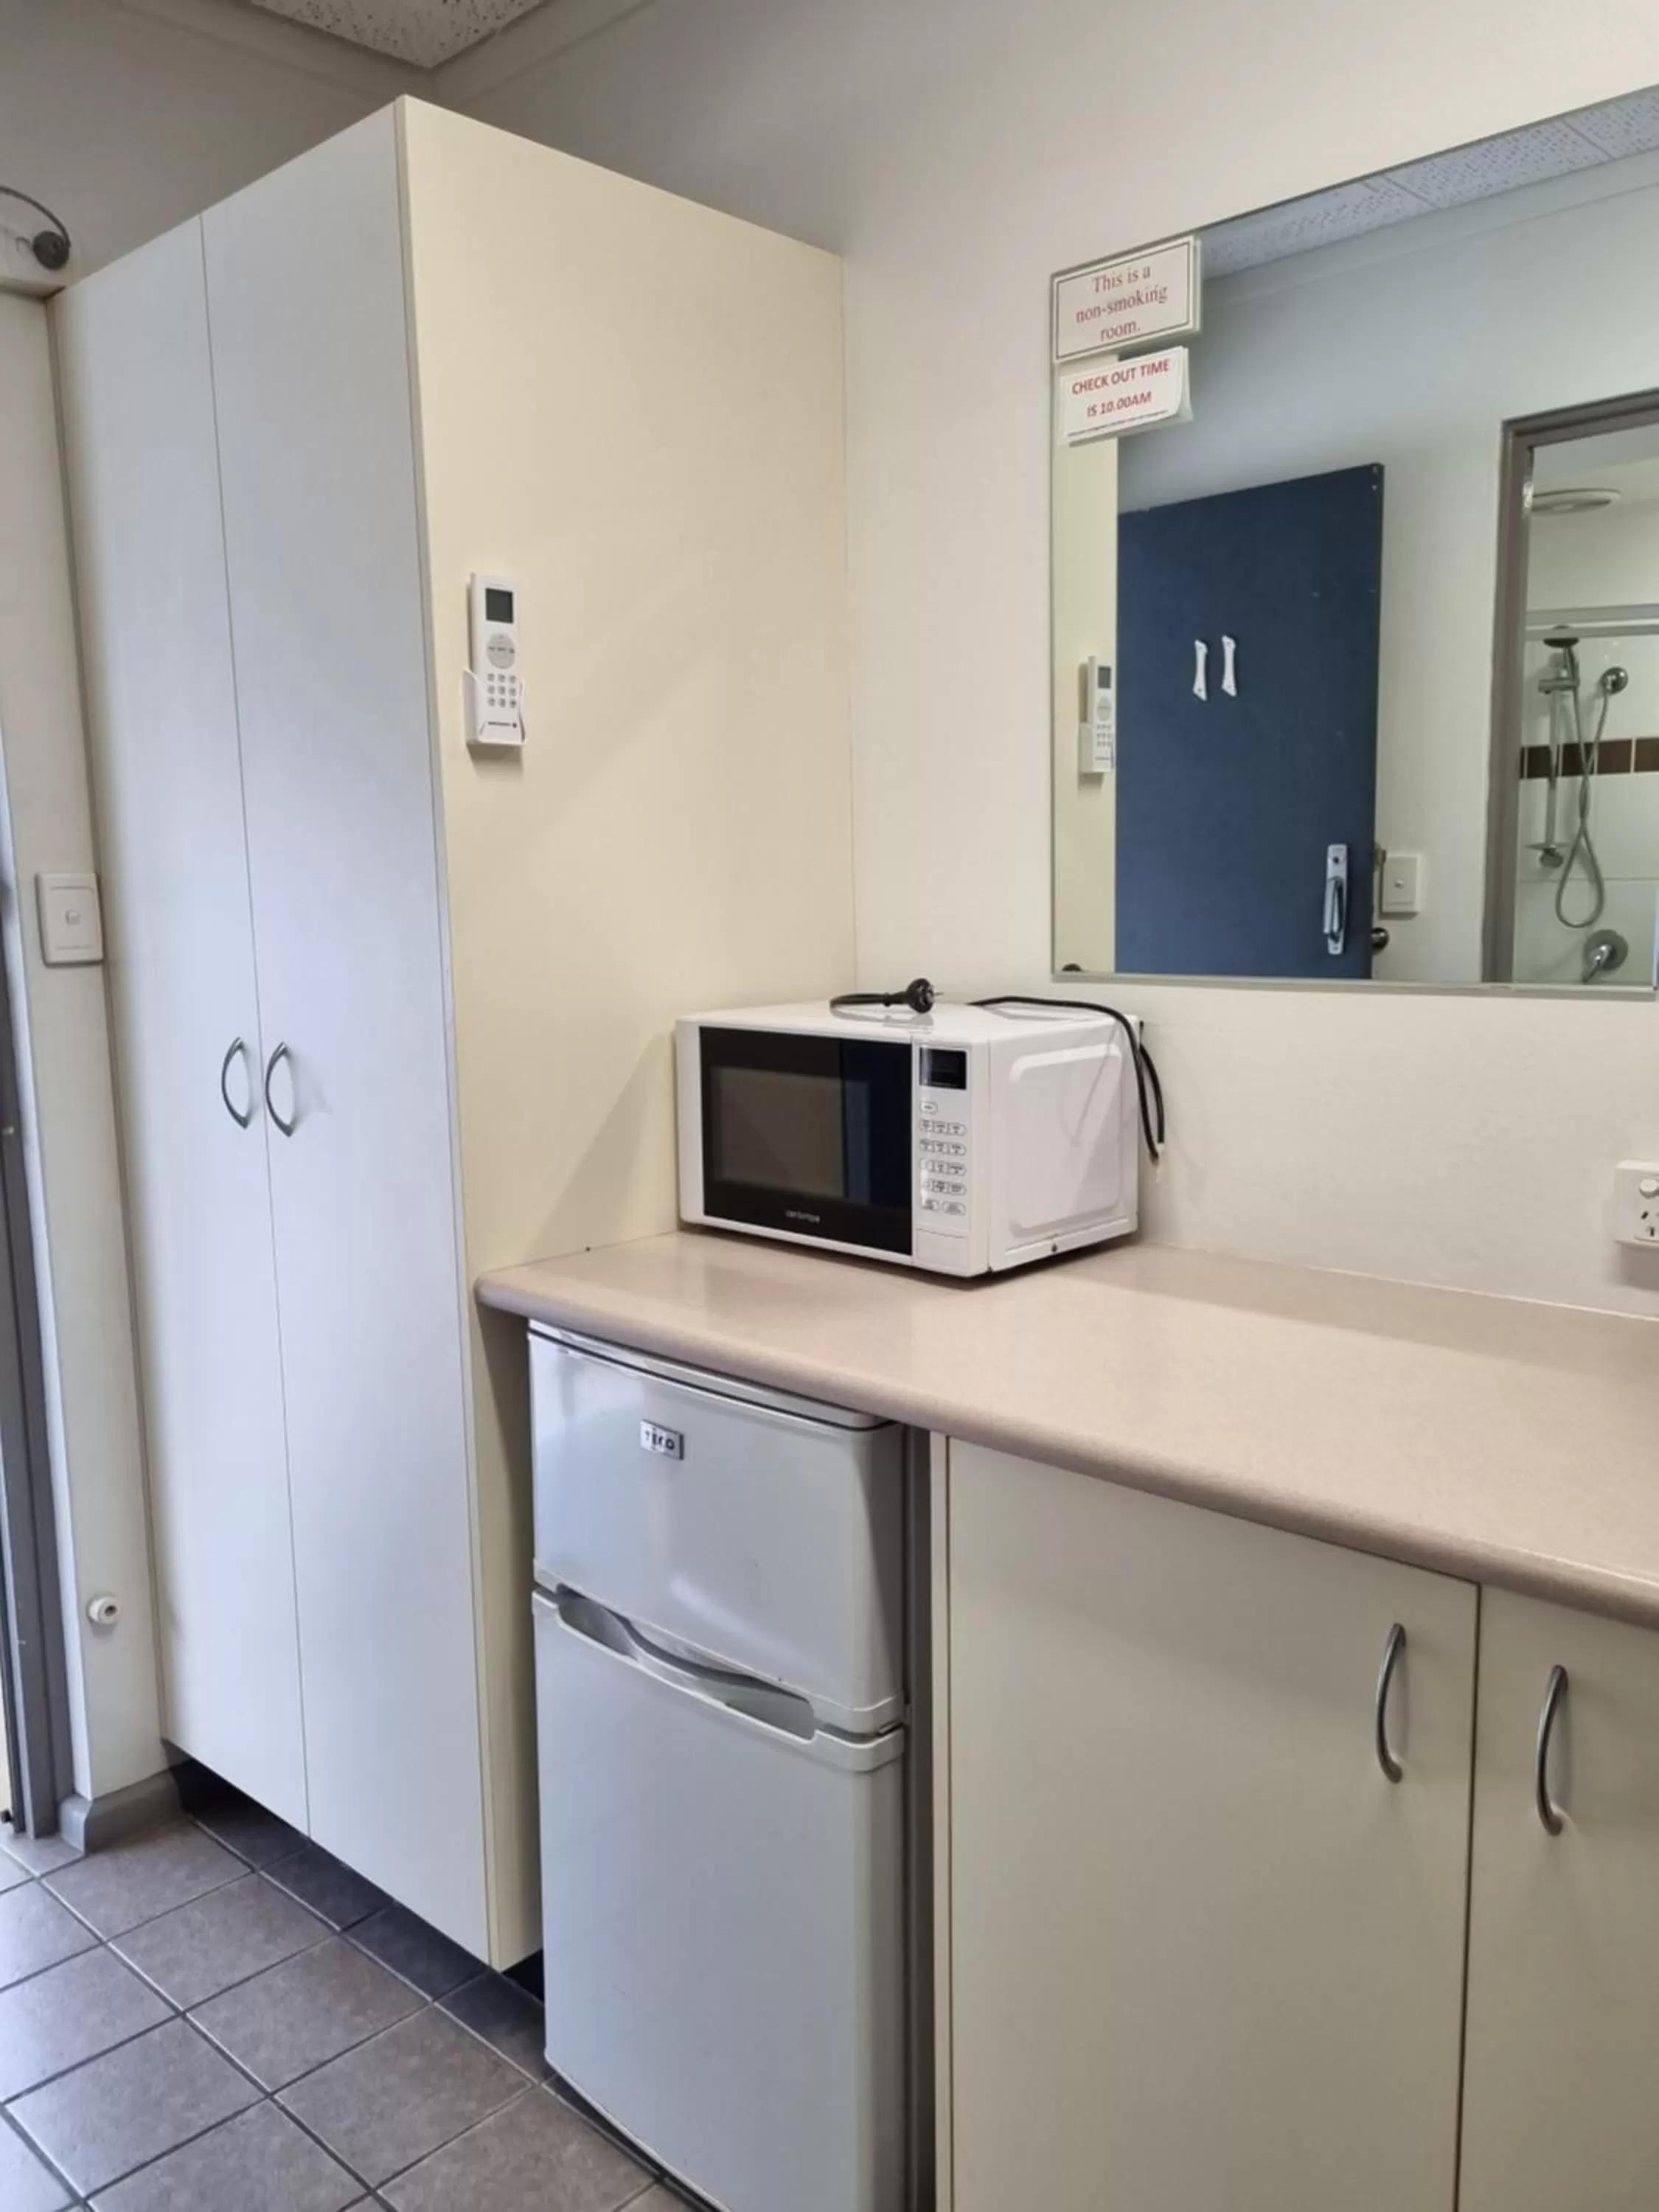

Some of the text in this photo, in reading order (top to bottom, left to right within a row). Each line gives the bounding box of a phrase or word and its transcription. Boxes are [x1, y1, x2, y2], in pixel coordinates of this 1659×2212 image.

[1091, 266, 1151, 293] This is a
[1076, 285, 1168, 323] non-smoking
[1100, 321, 1140, 341] room.
[1071, 358, 1171, 395] CHECK OUT TIME
[1087, 391, 1152, 417] IS 10.00AM
